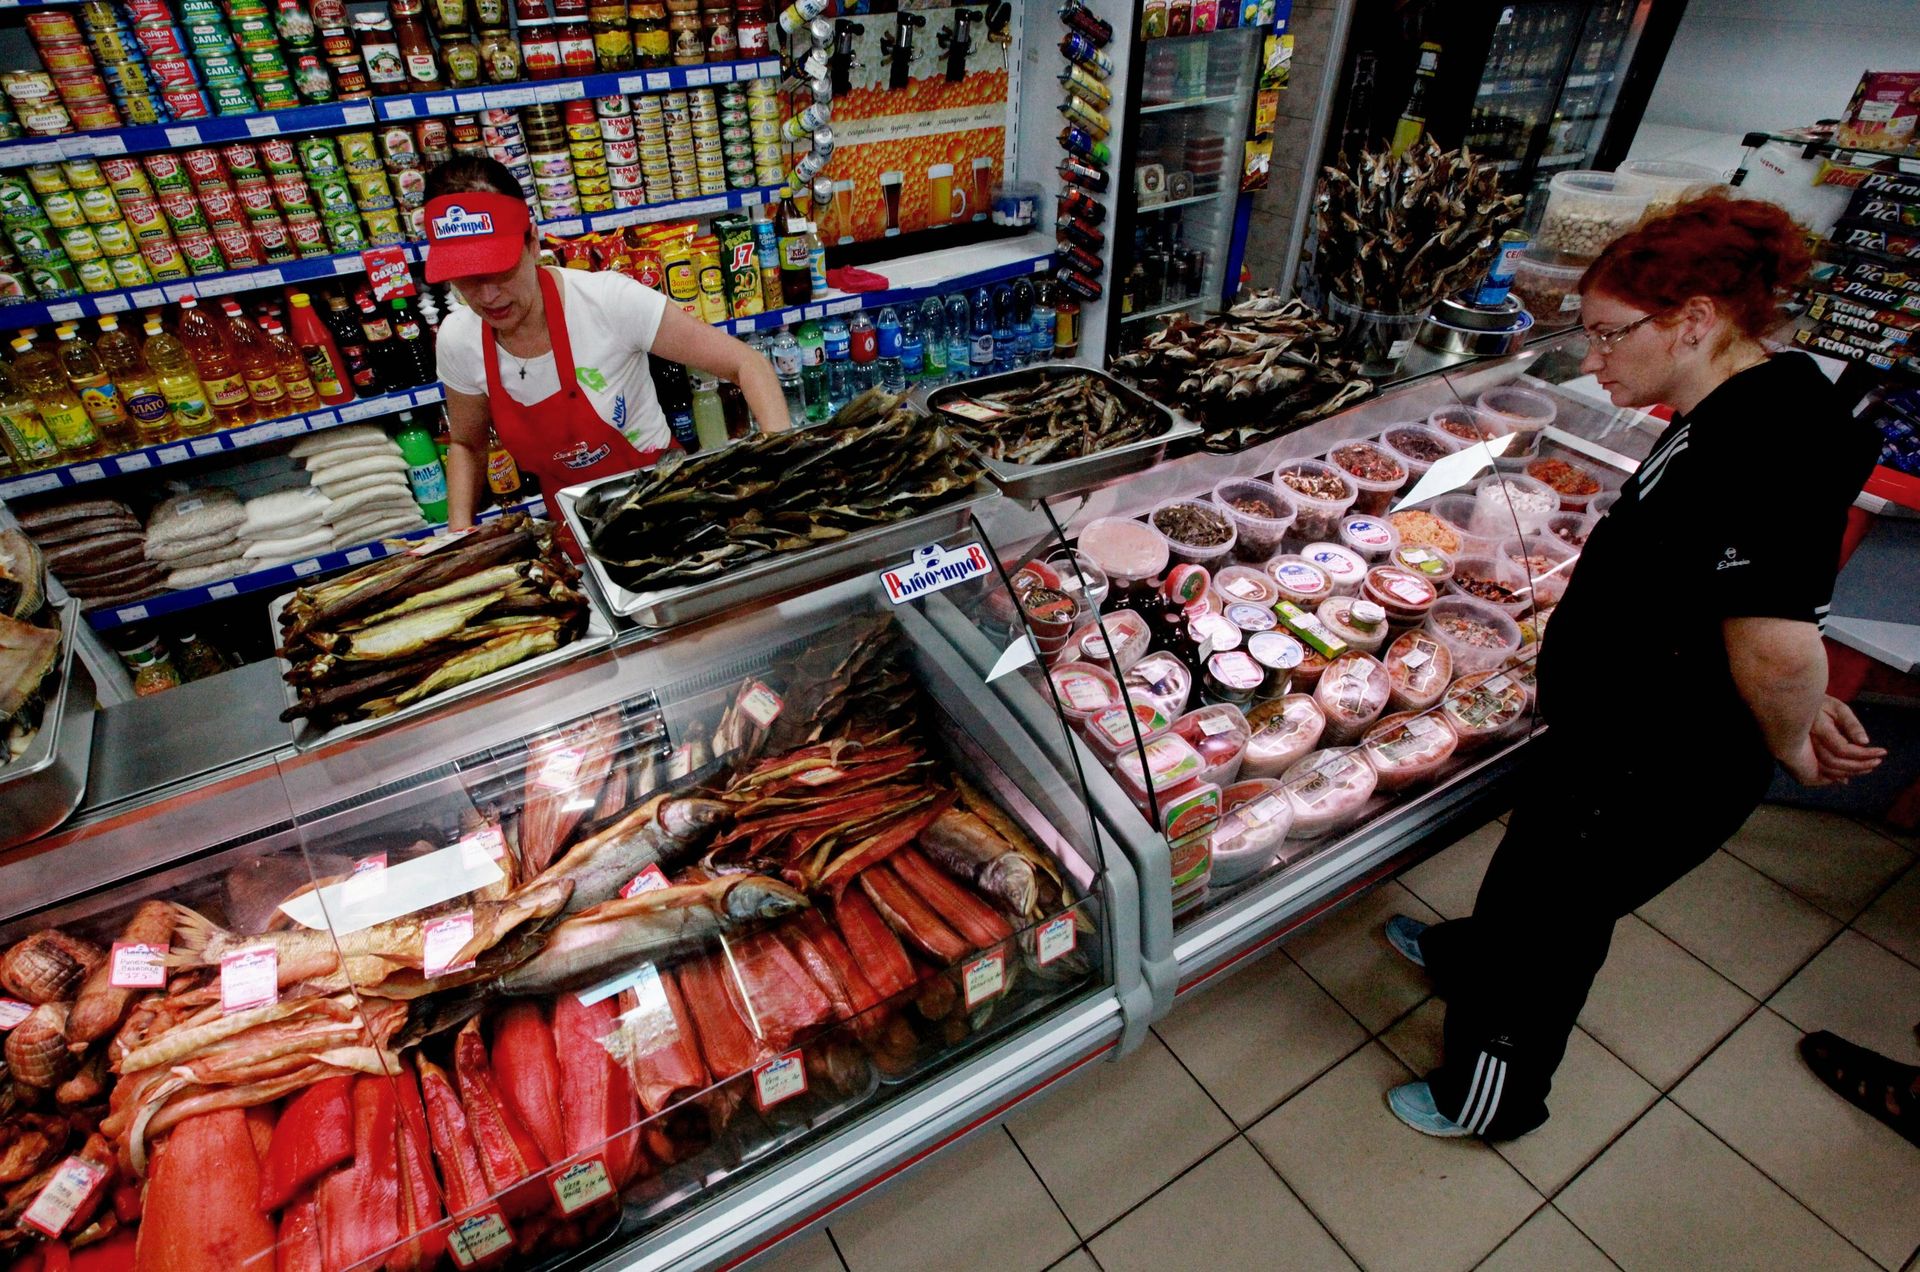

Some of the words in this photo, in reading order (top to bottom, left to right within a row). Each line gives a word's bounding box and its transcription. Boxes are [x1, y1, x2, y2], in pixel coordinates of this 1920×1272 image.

[139, 29, 170, 42] Сайра
[193, 34, 223, 44] САЛАТ
[155, 61, 186, 73] Сайра
[206, 66, 236, 76] САЛАТ
[168, 91, 198, 105] Сайра
[219, 97, 249, 107] САЛАТ
[371, 262, 406, 282] Сахар
[1844, 282, 1898, 303] Picnic
[1831, 312, 1880, 334] TEMPO
[1817, 337, 1864, 359] TEMPO
[612, 394, 625, 423] NIKE
[413, 463, 441, 482] Milkis
[885, 546, 987, 599] РыбомироВ
